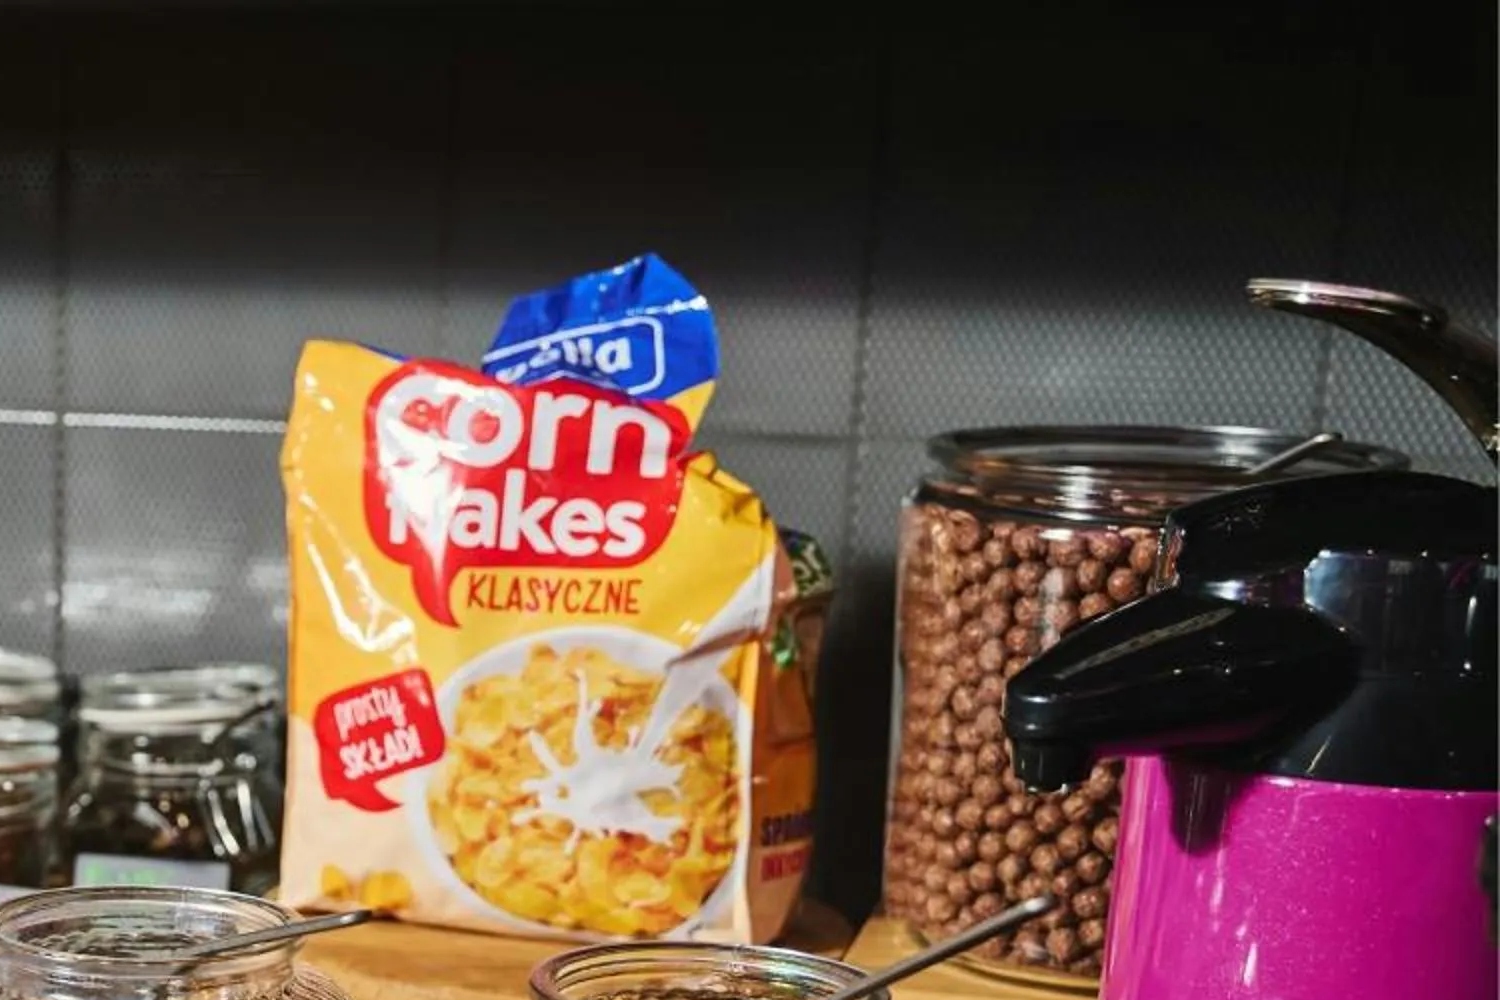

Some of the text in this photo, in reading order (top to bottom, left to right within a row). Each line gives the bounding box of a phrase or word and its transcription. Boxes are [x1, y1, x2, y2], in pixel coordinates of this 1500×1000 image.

[376, 373, 672, 478] corn
[386, 468, 647, 558] fakes
[466, 573, 643, 615] KLASYCZNE
